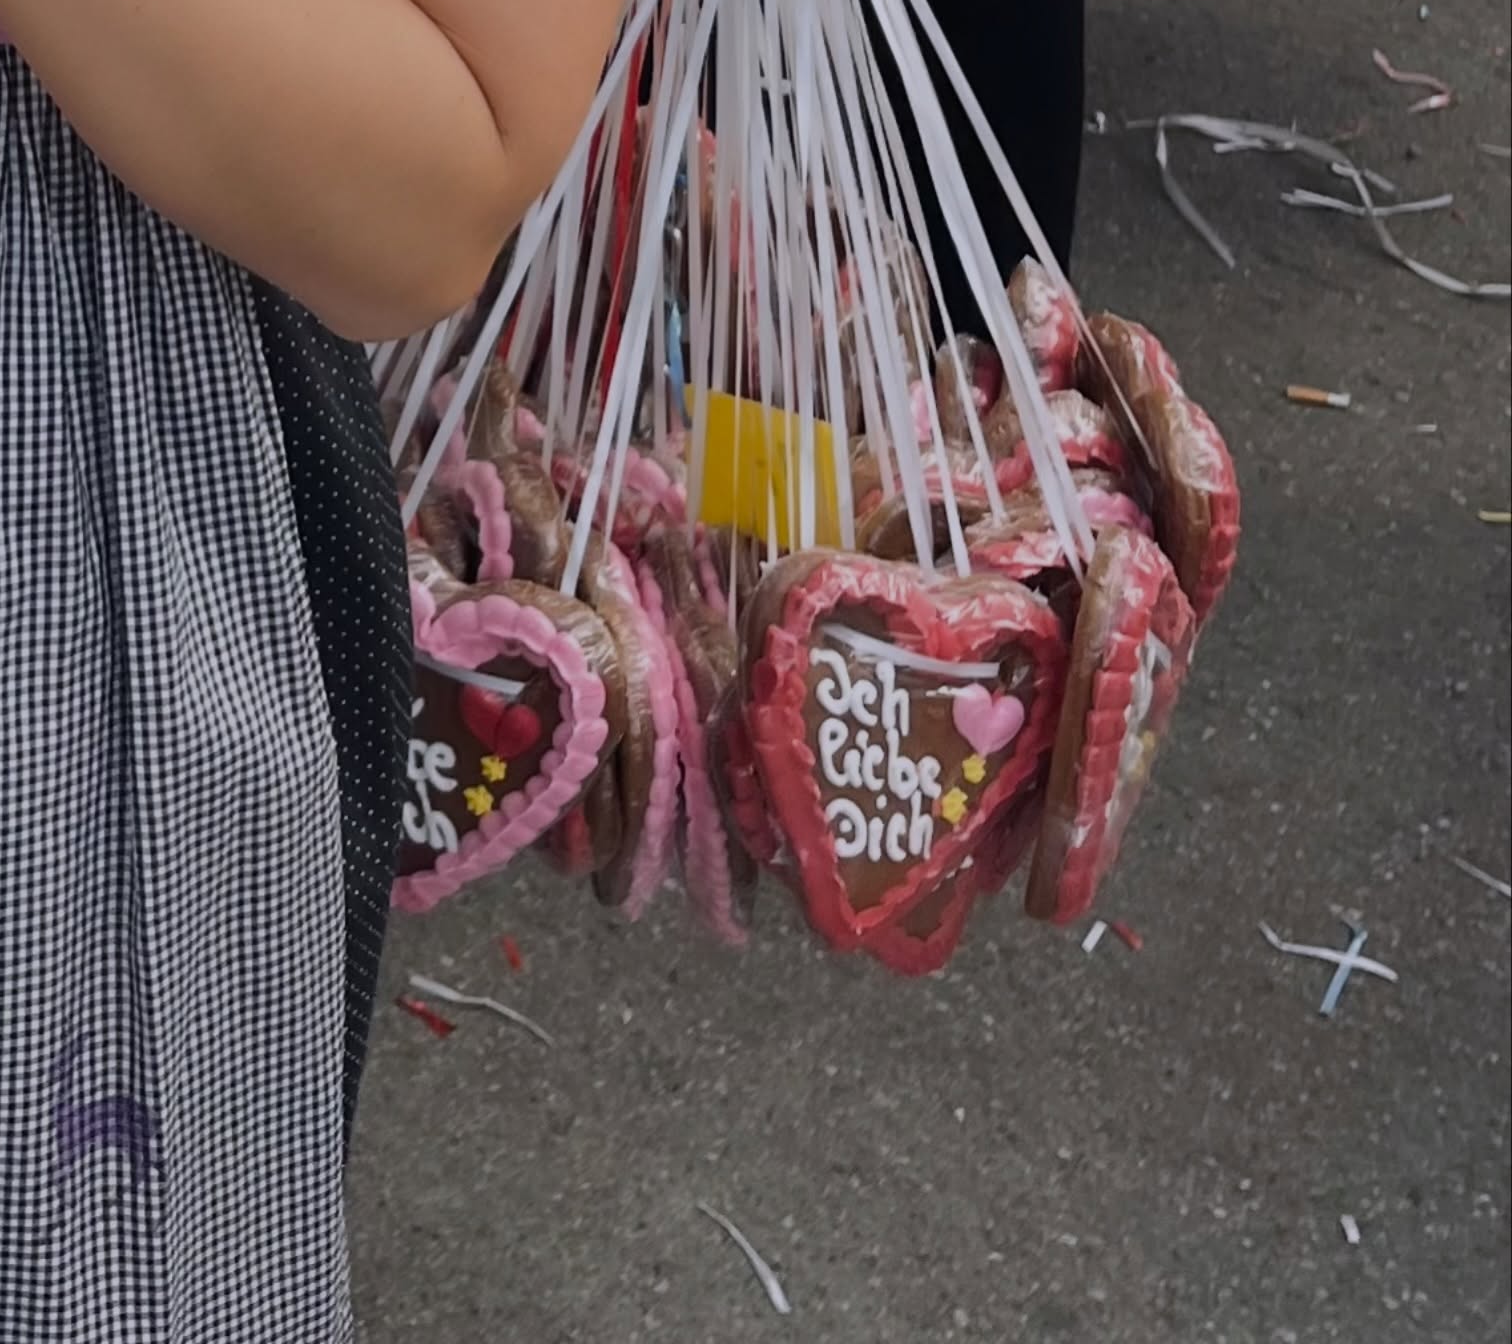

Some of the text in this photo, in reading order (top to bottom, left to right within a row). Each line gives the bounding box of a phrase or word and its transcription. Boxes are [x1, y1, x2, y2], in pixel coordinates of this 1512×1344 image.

[809, 647, 910, 738] Ich
[818, 716, 942, 800] liebe
[824, 789, 935, 863] Dich
